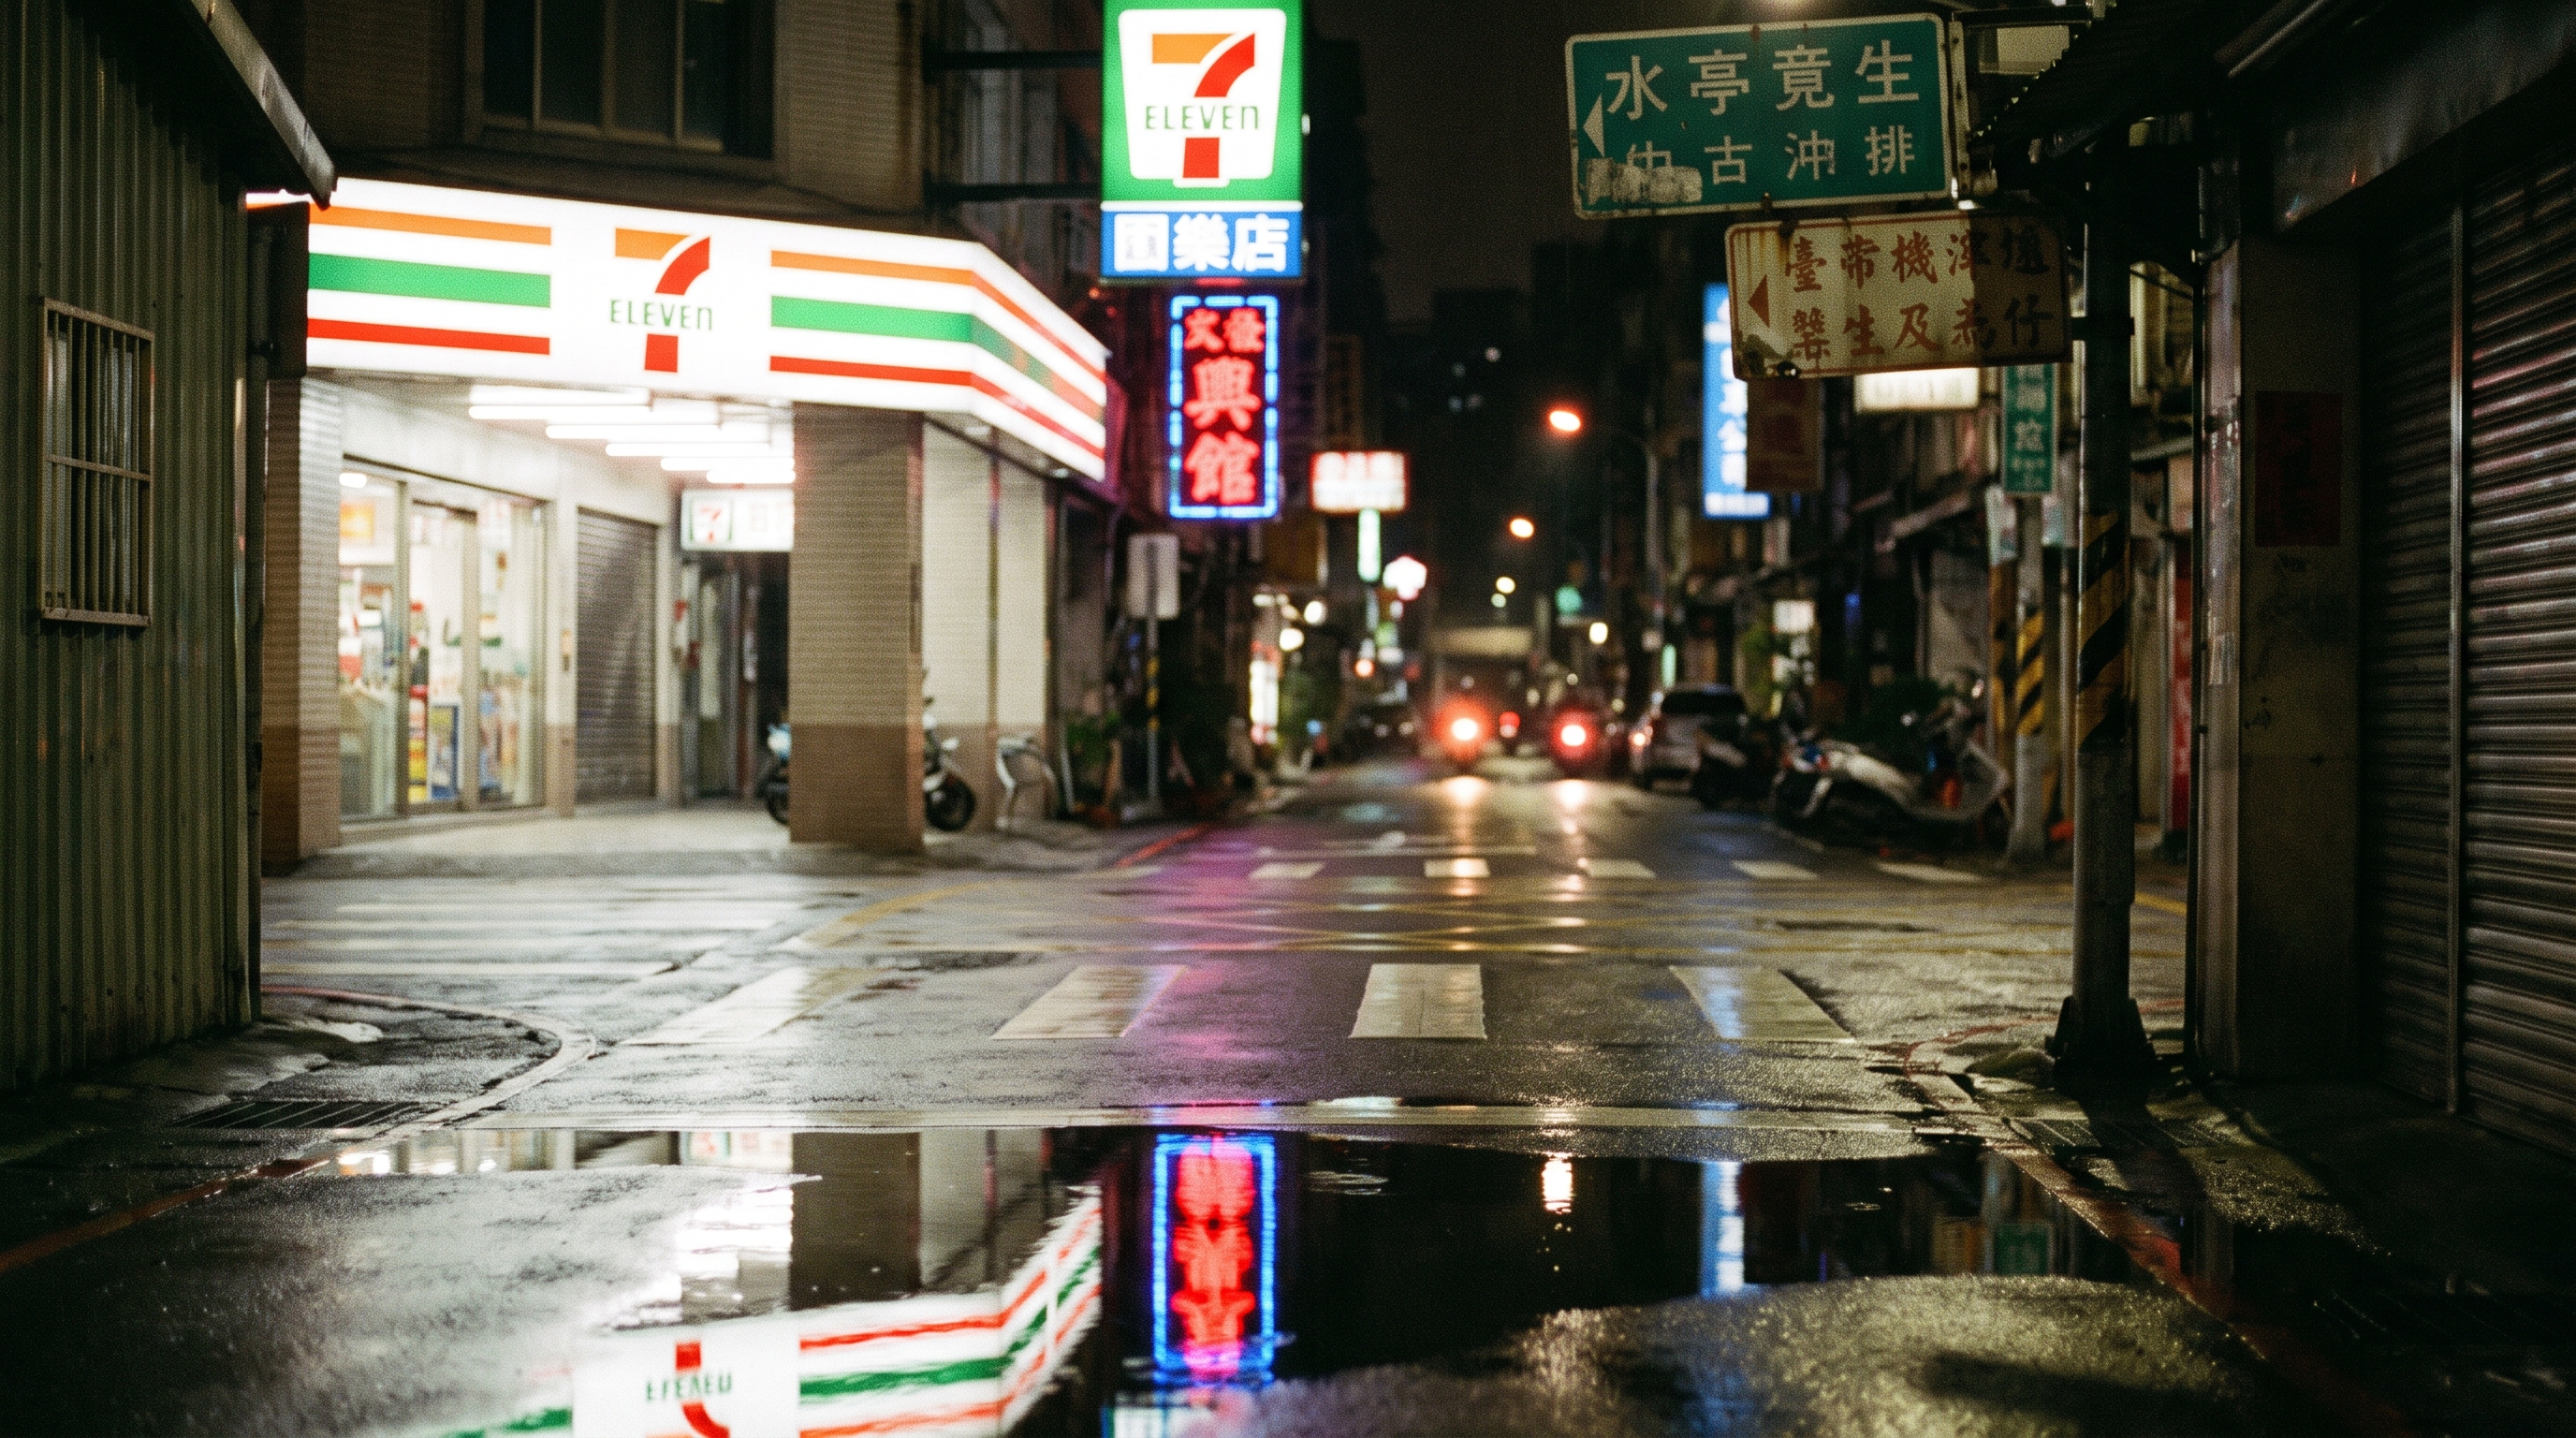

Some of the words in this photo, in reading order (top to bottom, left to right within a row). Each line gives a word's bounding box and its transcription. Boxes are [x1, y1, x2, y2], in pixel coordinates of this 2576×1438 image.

[1151, 33, 1255, 178] 7
[1604, 39, 1920, 121] 水亭竟生
[615, 227, 710, 374] 7
